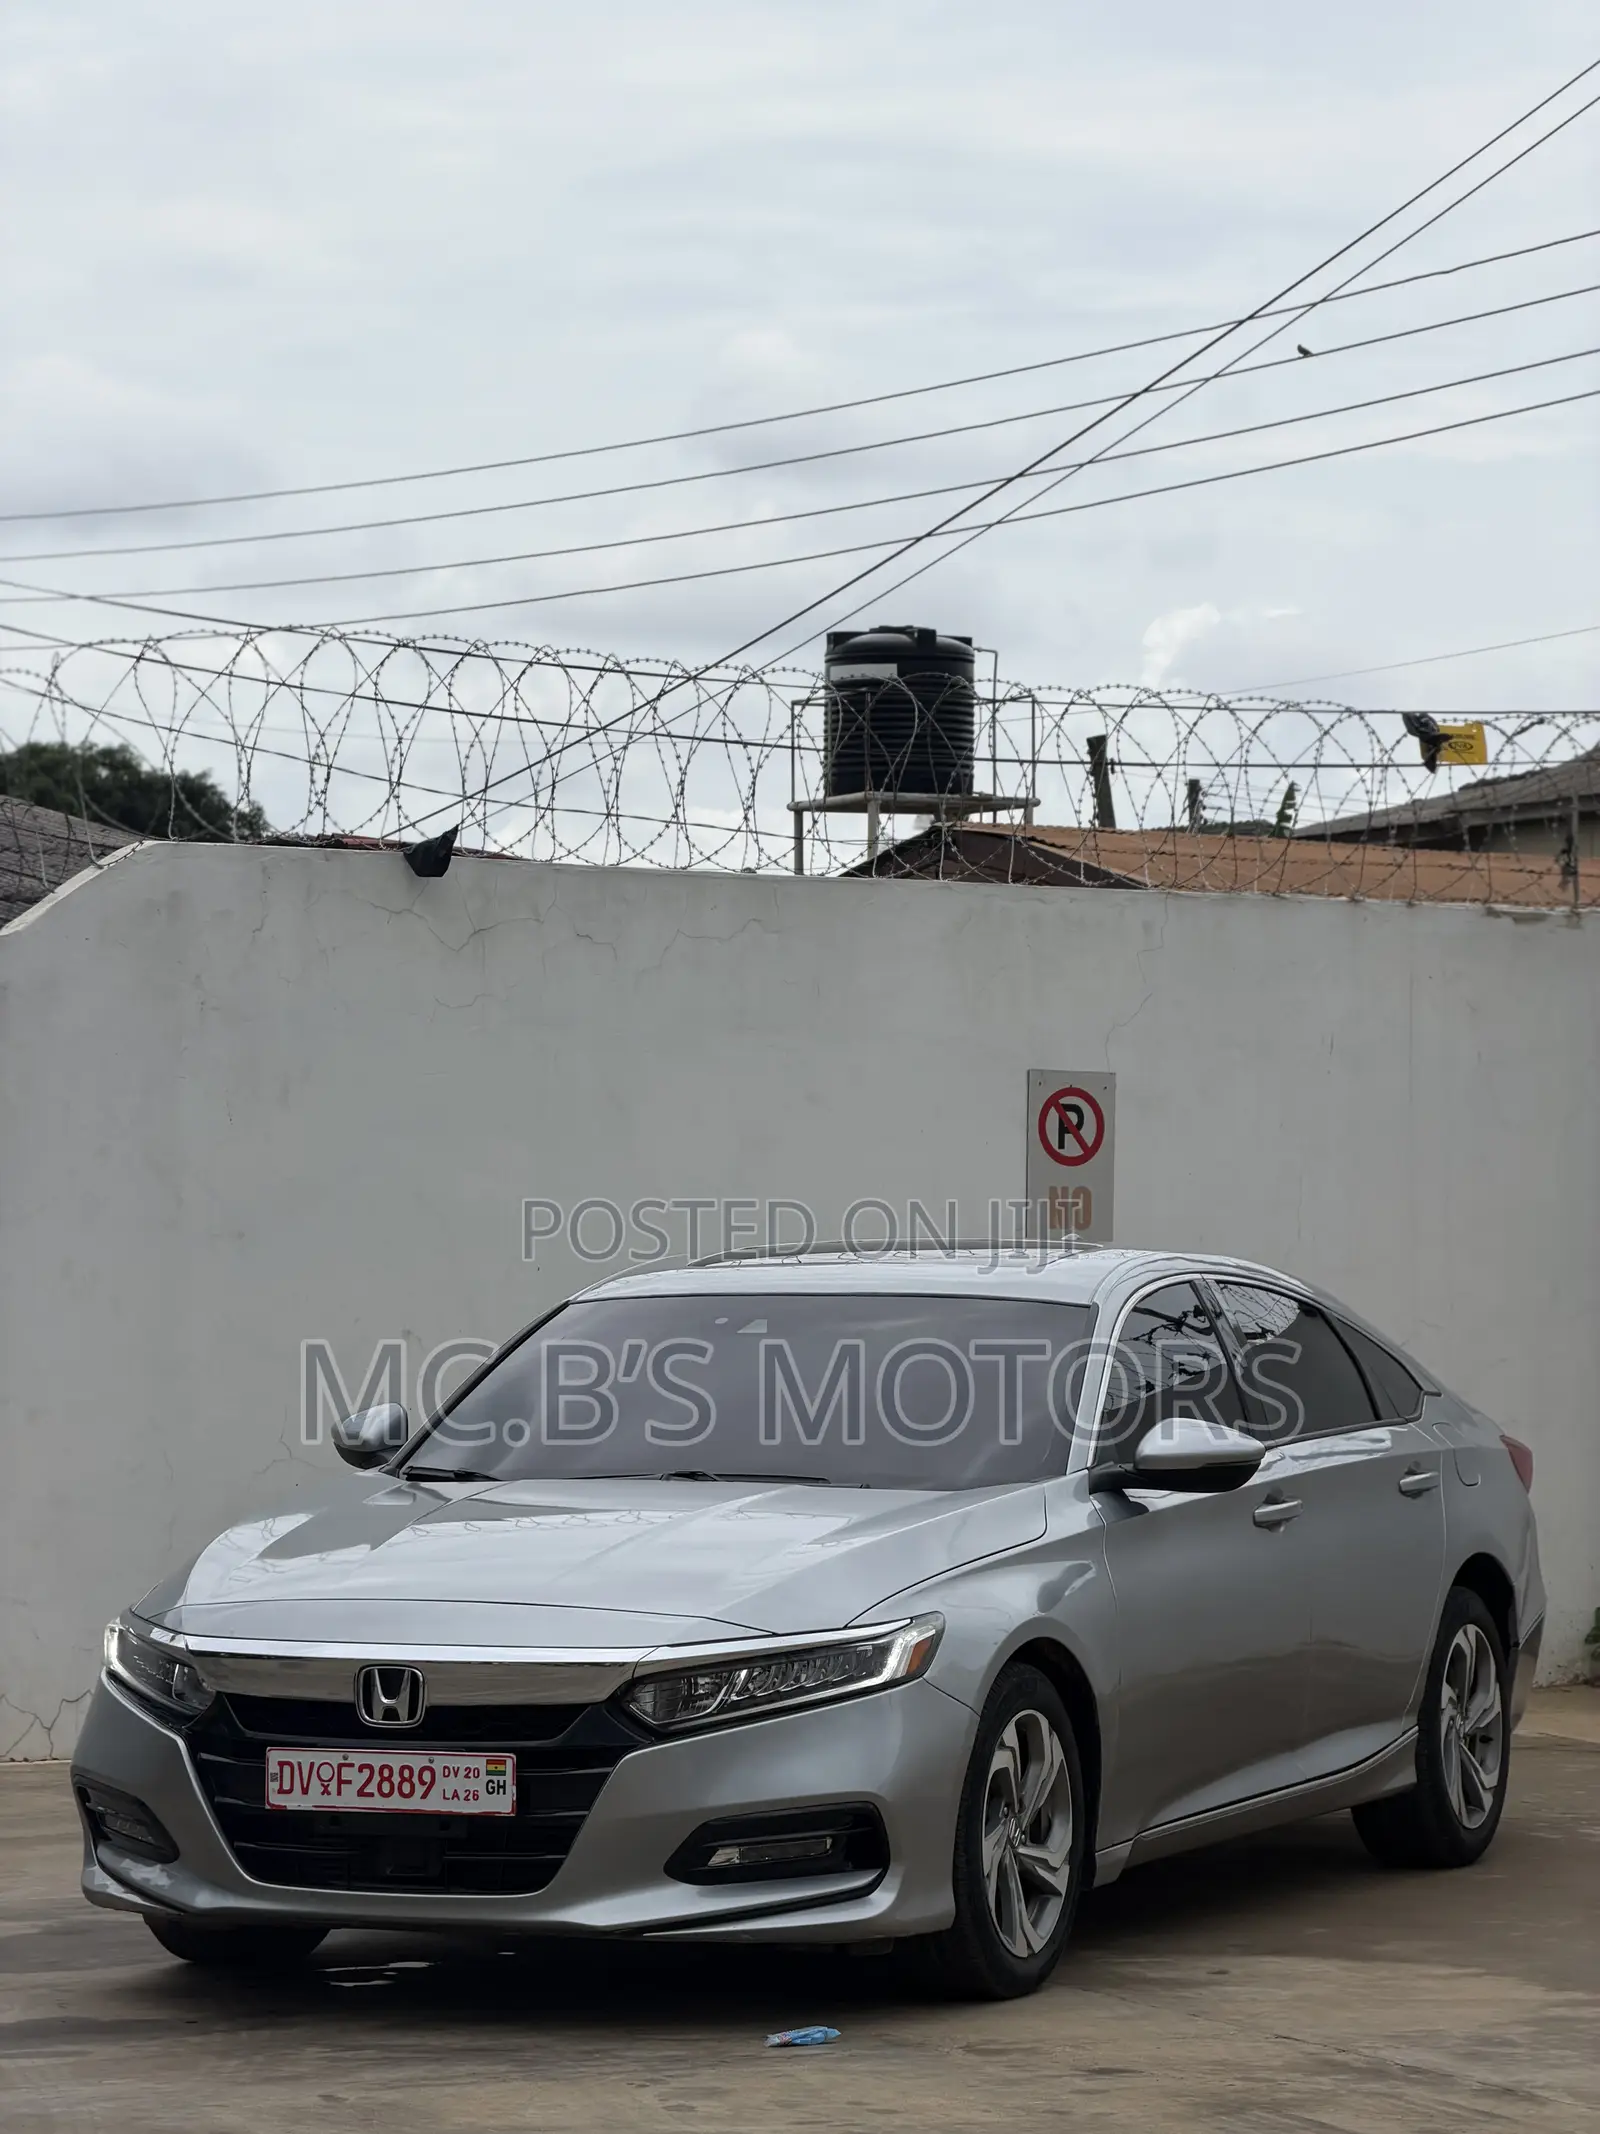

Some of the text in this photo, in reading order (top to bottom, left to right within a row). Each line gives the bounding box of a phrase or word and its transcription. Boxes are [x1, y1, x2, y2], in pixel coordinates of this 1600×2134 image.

[1049, 1186, 1092, 1231] NO
[442, 1765, 481, 1780] DV 20
[442, 1788, 480, 1802] LA 26
[485, 1779, 507, 1796] GH
